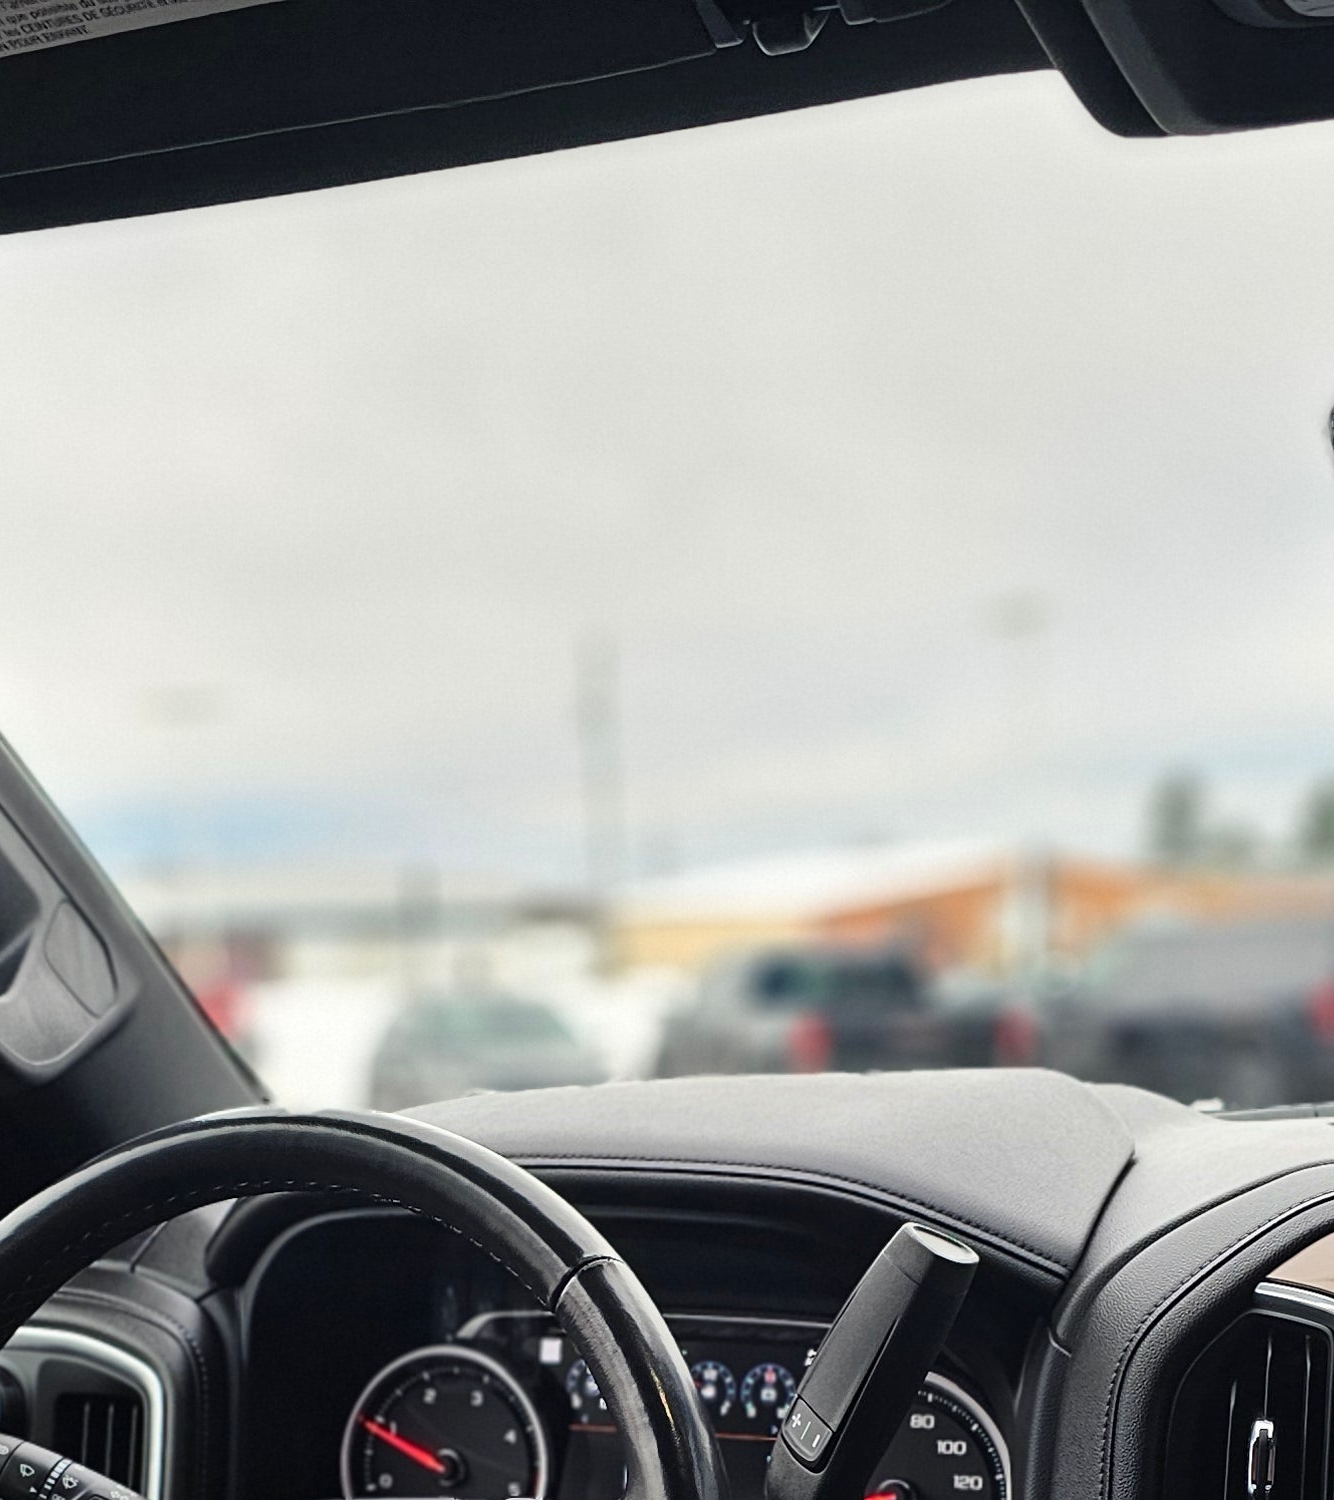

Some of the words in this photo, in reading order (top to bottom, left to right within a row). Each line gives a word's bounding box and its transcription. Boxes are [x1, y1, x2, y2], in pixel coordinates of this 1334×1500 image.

[424, 1387, 437, 1404] 2
[910, 1414, 935, 1430] 80
[937, 1439, 967, 1456] 100
[953, 1474, 984, 1491] 120
